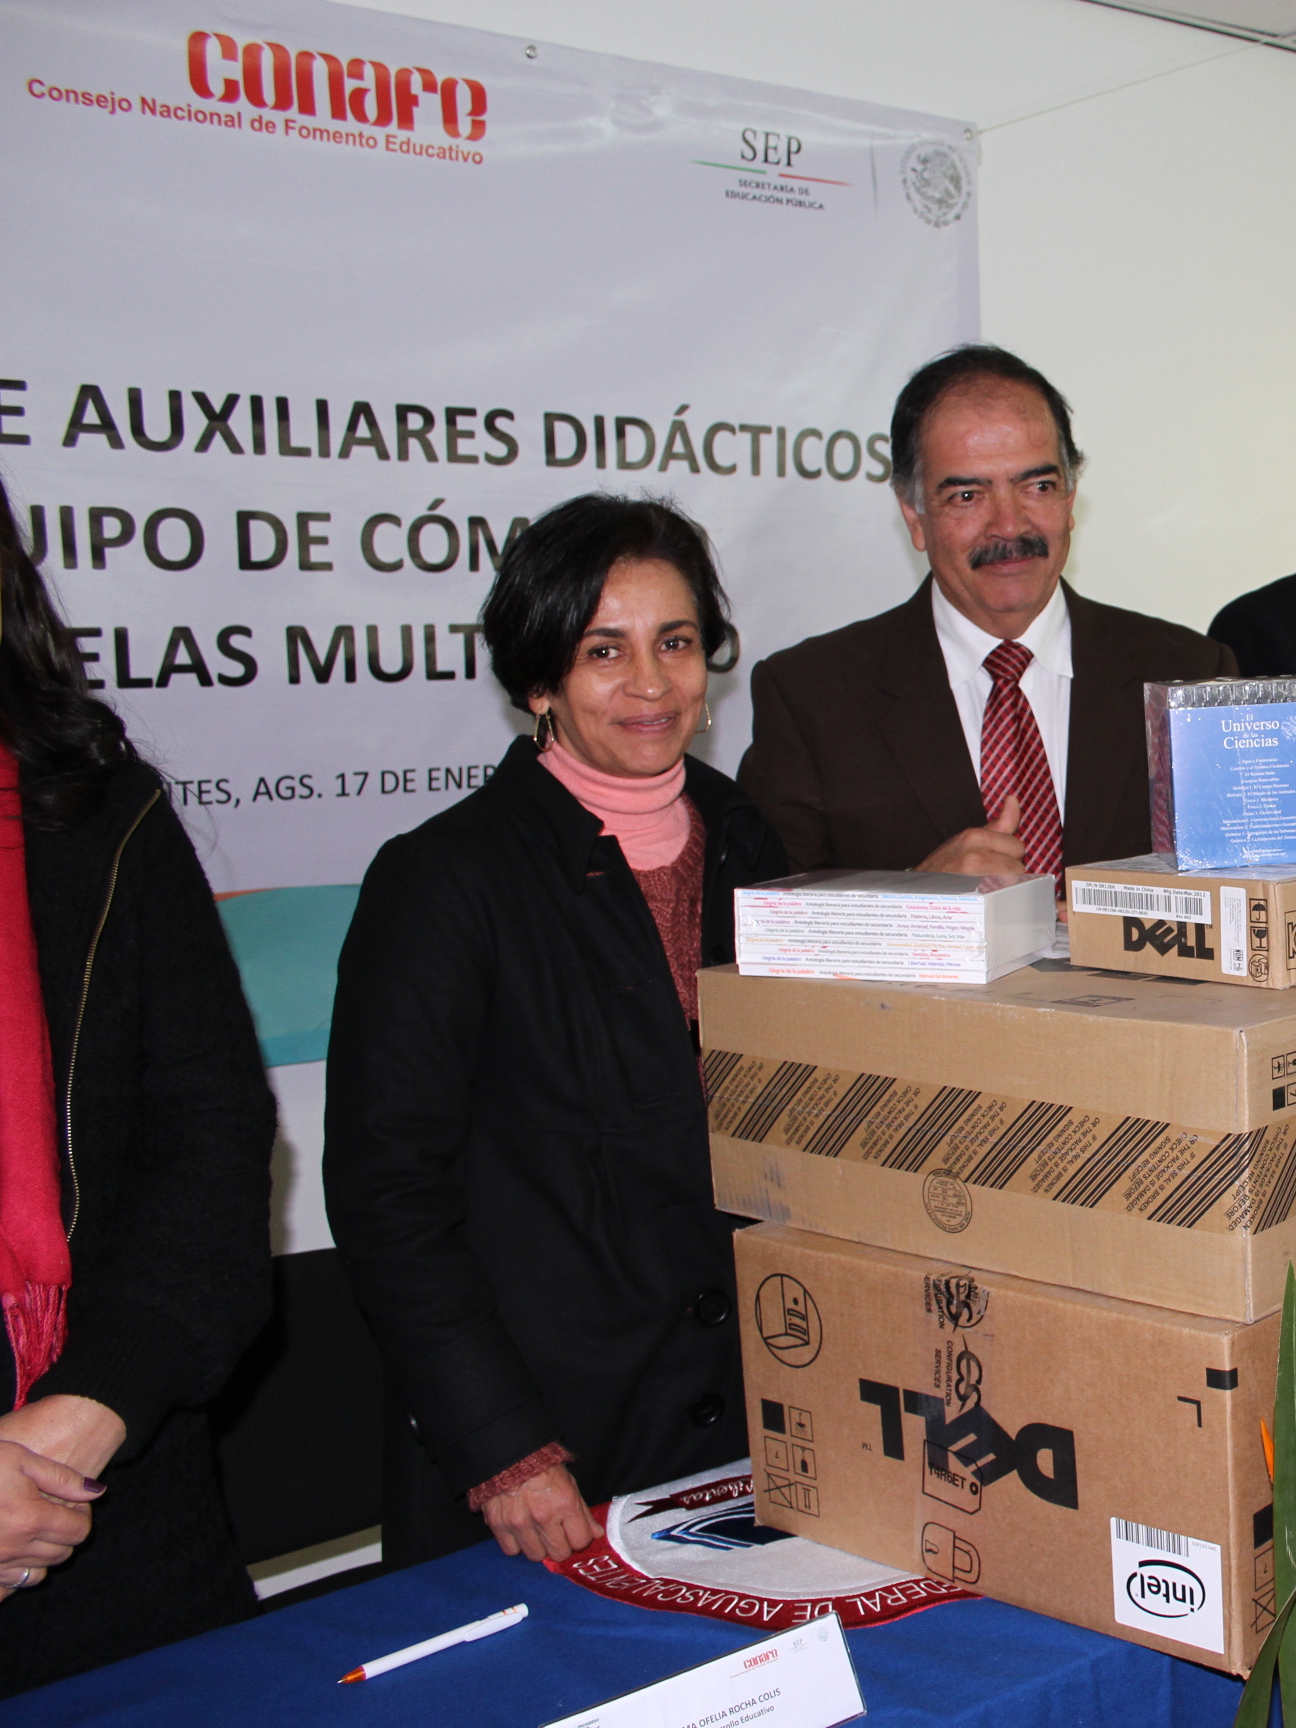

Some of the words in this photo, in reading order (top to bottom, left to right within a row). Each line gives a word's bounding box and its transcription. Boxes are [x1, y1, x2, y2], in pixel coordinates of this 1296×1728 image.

[187, 30, 488, 142] conafe
[27, 77, 133, 115] Consejo
[140, 91, 243, 130] Nacional
[250, 115, 277, 135] de
[284, 118, 378, 149] Fomento
[385, 134, 484, 165] Educativo
[740, 127, 802, 167] SEP
[738, 178, 795, 194] SECRETARÍA
[798, 187, 810, 196] DE
[725, 189, 783, 205] EDUCACIÓN
[785, 197, 824, 210] PÚBLICA
[62, 383, 519, 467] AUXILIARES
[543, 405, 893, 484] DIDÁCTICOS
[236, 509, 333, 572] DE
[1221, 719, 1280, 732] Universo
[1223, 734, 1279, 749] Ciencias
[253, 775, 323, 802] AGS.
[335, 771, 369, 798] 17
[380, 769, 416, 795] DE
[1123, 916, 1214, 960] DELL
[1053, 1118, 1073, 1142] SIGNING
[1072, 1114, 1089, 1135] CHECK
[1081, 1125, 1091, 1138] THE
[1033, 1140, 1054, 1164] RECEIPT
[1047, 1132, 1072, 1162] CONTENTS
[1058, 1136, 1081, 1163] PACKAGE
[1079, 1140, 1091, 1154] THIS
[1149, 1135, 1170, 1160] SIGNING
[1168, 1131, 1187, 1152] CHECK
[1178, 1142, 1189, 1156] THE
[1029, 1159, 1048, 1182] BEFORE
[1067, 1151, 1080, 1167] SEAL
[1128, 1157, 1149, 1182] RECEIPT
[1142, 1150, 1169, 1180] CONTENTS
[1155, 1153, 1179, 1181] PACKAGE
[1176, 1157, 1189, 1172] THIS
[1044, 1171, 1062, 1193] BROKEN
[1123, 1177, 1144, 1201] BEFORE
[1164, 1169, 1178, 1185] SEAL
[1125, 1184, 1150, 1213] DAMAGED:
[1138, 1189, 1159, 1213] BROKEN
[934, 1348, 942, 1389] SERVICES
[945, 1340, 954, 1407] CONFIGURATION
[859, 1378, 1079, 1510] DELL
[573, 1555, 784, 1622] AGUASCALIENTES
[1140, 1572, 1195, 1613] intel
[792, 1601, 833, 1623] DE
[699, 1710, 728, 1728] OFELIA
[728, 1698, 758, 1716] ROCHA
[758, 1688, 782, 1703] COLIS
[740, 1705, 775, 1724] Educativo
